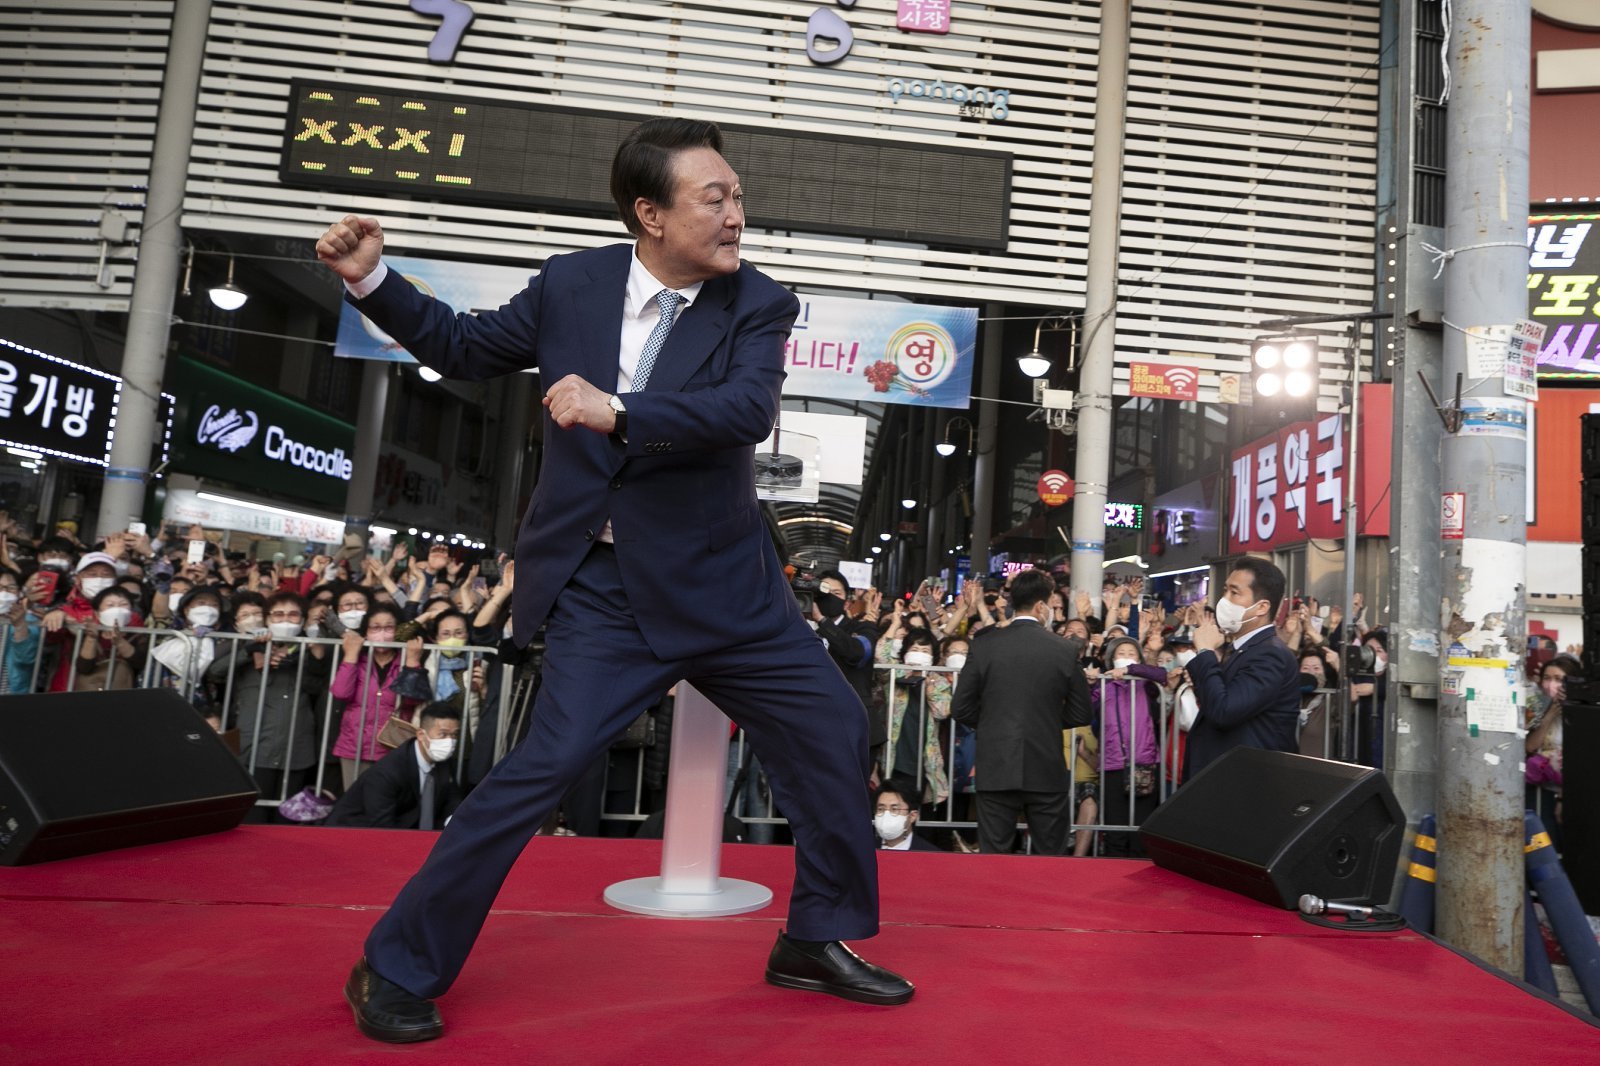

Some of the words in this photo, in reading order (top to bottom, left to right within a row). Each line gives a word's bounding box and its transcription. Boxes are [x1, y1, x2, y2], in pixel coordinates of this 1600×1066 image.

[900, 10, 946, 29] 시장
[1527, 223, 1592, 268] 년
[1527, 273, 1600, 316] "포
[783, 339, 860, 374] 니다!
[905, 338, 936, 376] 영
[1536, 323, 1600, 368] 시
[264, 426, 353, 481] Crocodile
[1230, 413, 1344, 543] 개풍약국
